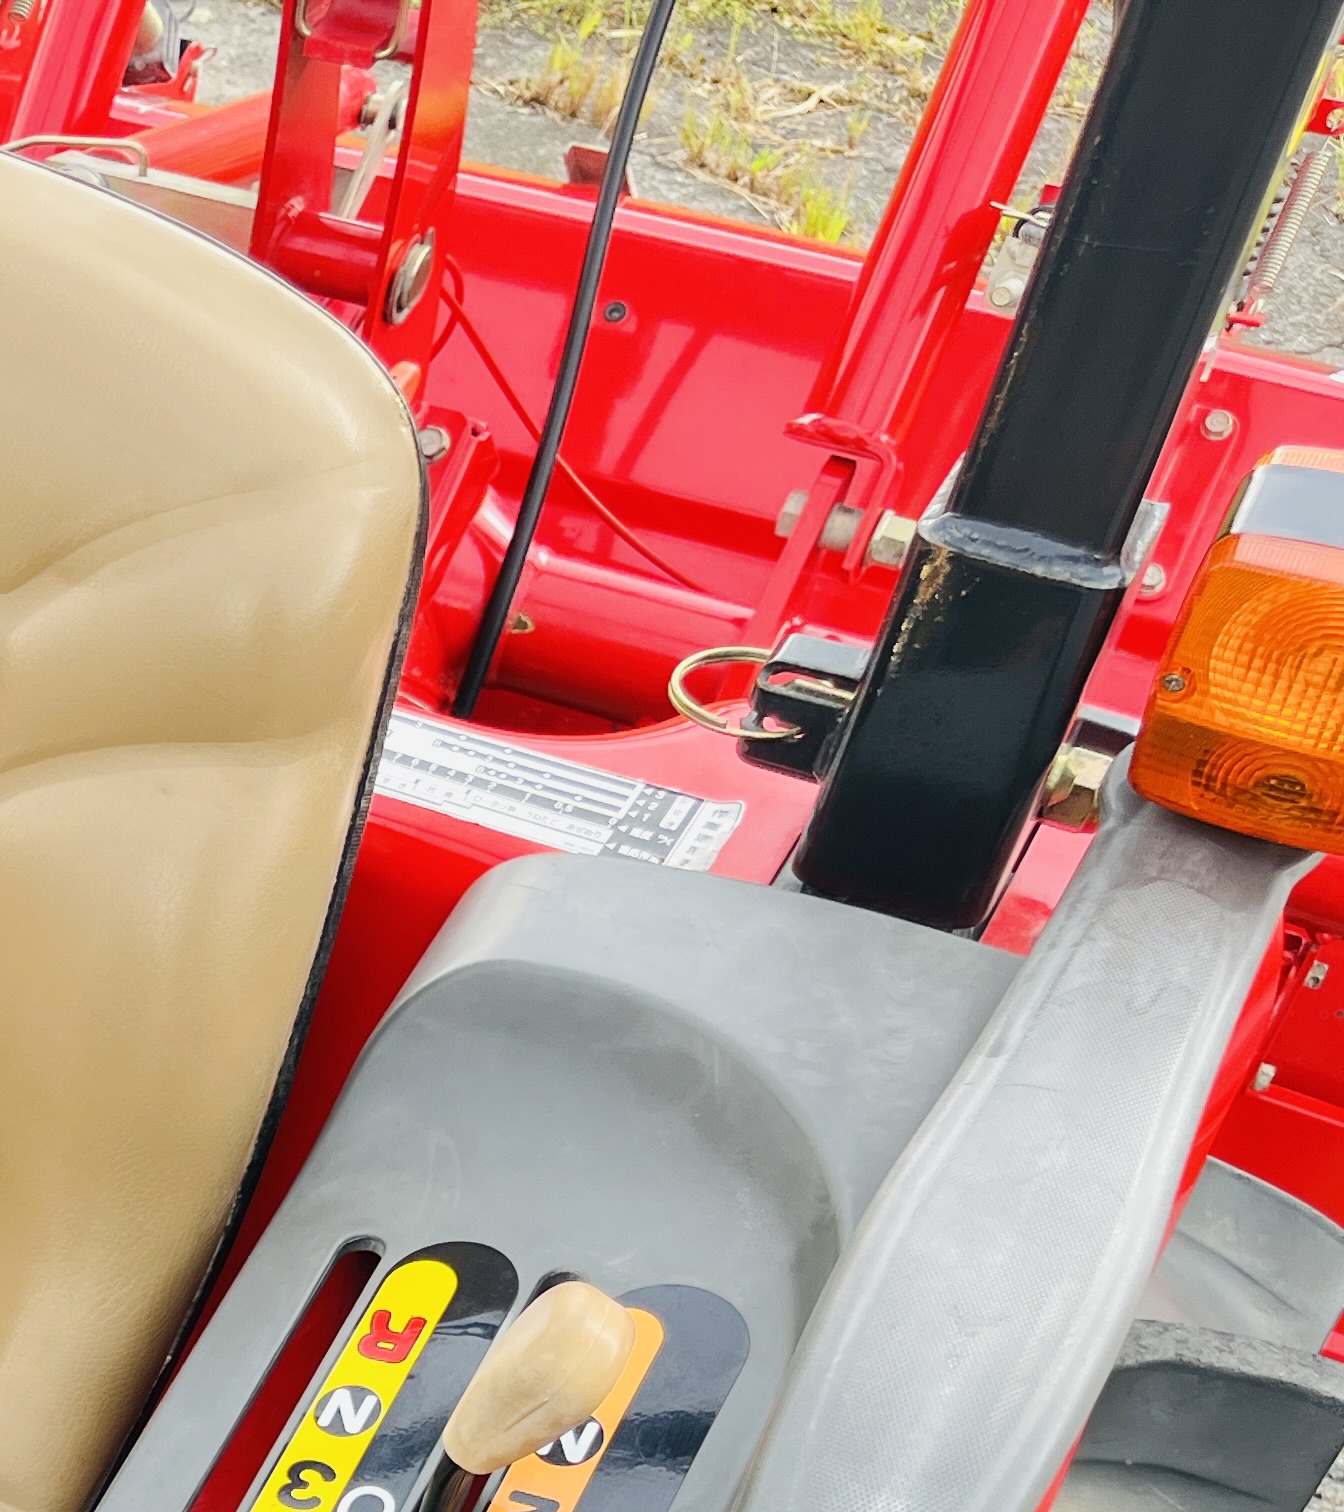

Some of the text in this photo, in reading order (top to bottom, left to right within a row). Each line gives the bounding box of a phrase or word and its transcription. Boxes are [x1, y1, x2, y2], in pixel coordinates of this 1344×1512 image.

[647, 801, 659, 811] 2
[356, 1312, 429, 1364] R
[317, 1388, 379, 1434] N
[537, 1418, 601, 1465] N
[276, 1459, 337, 1510] 3
